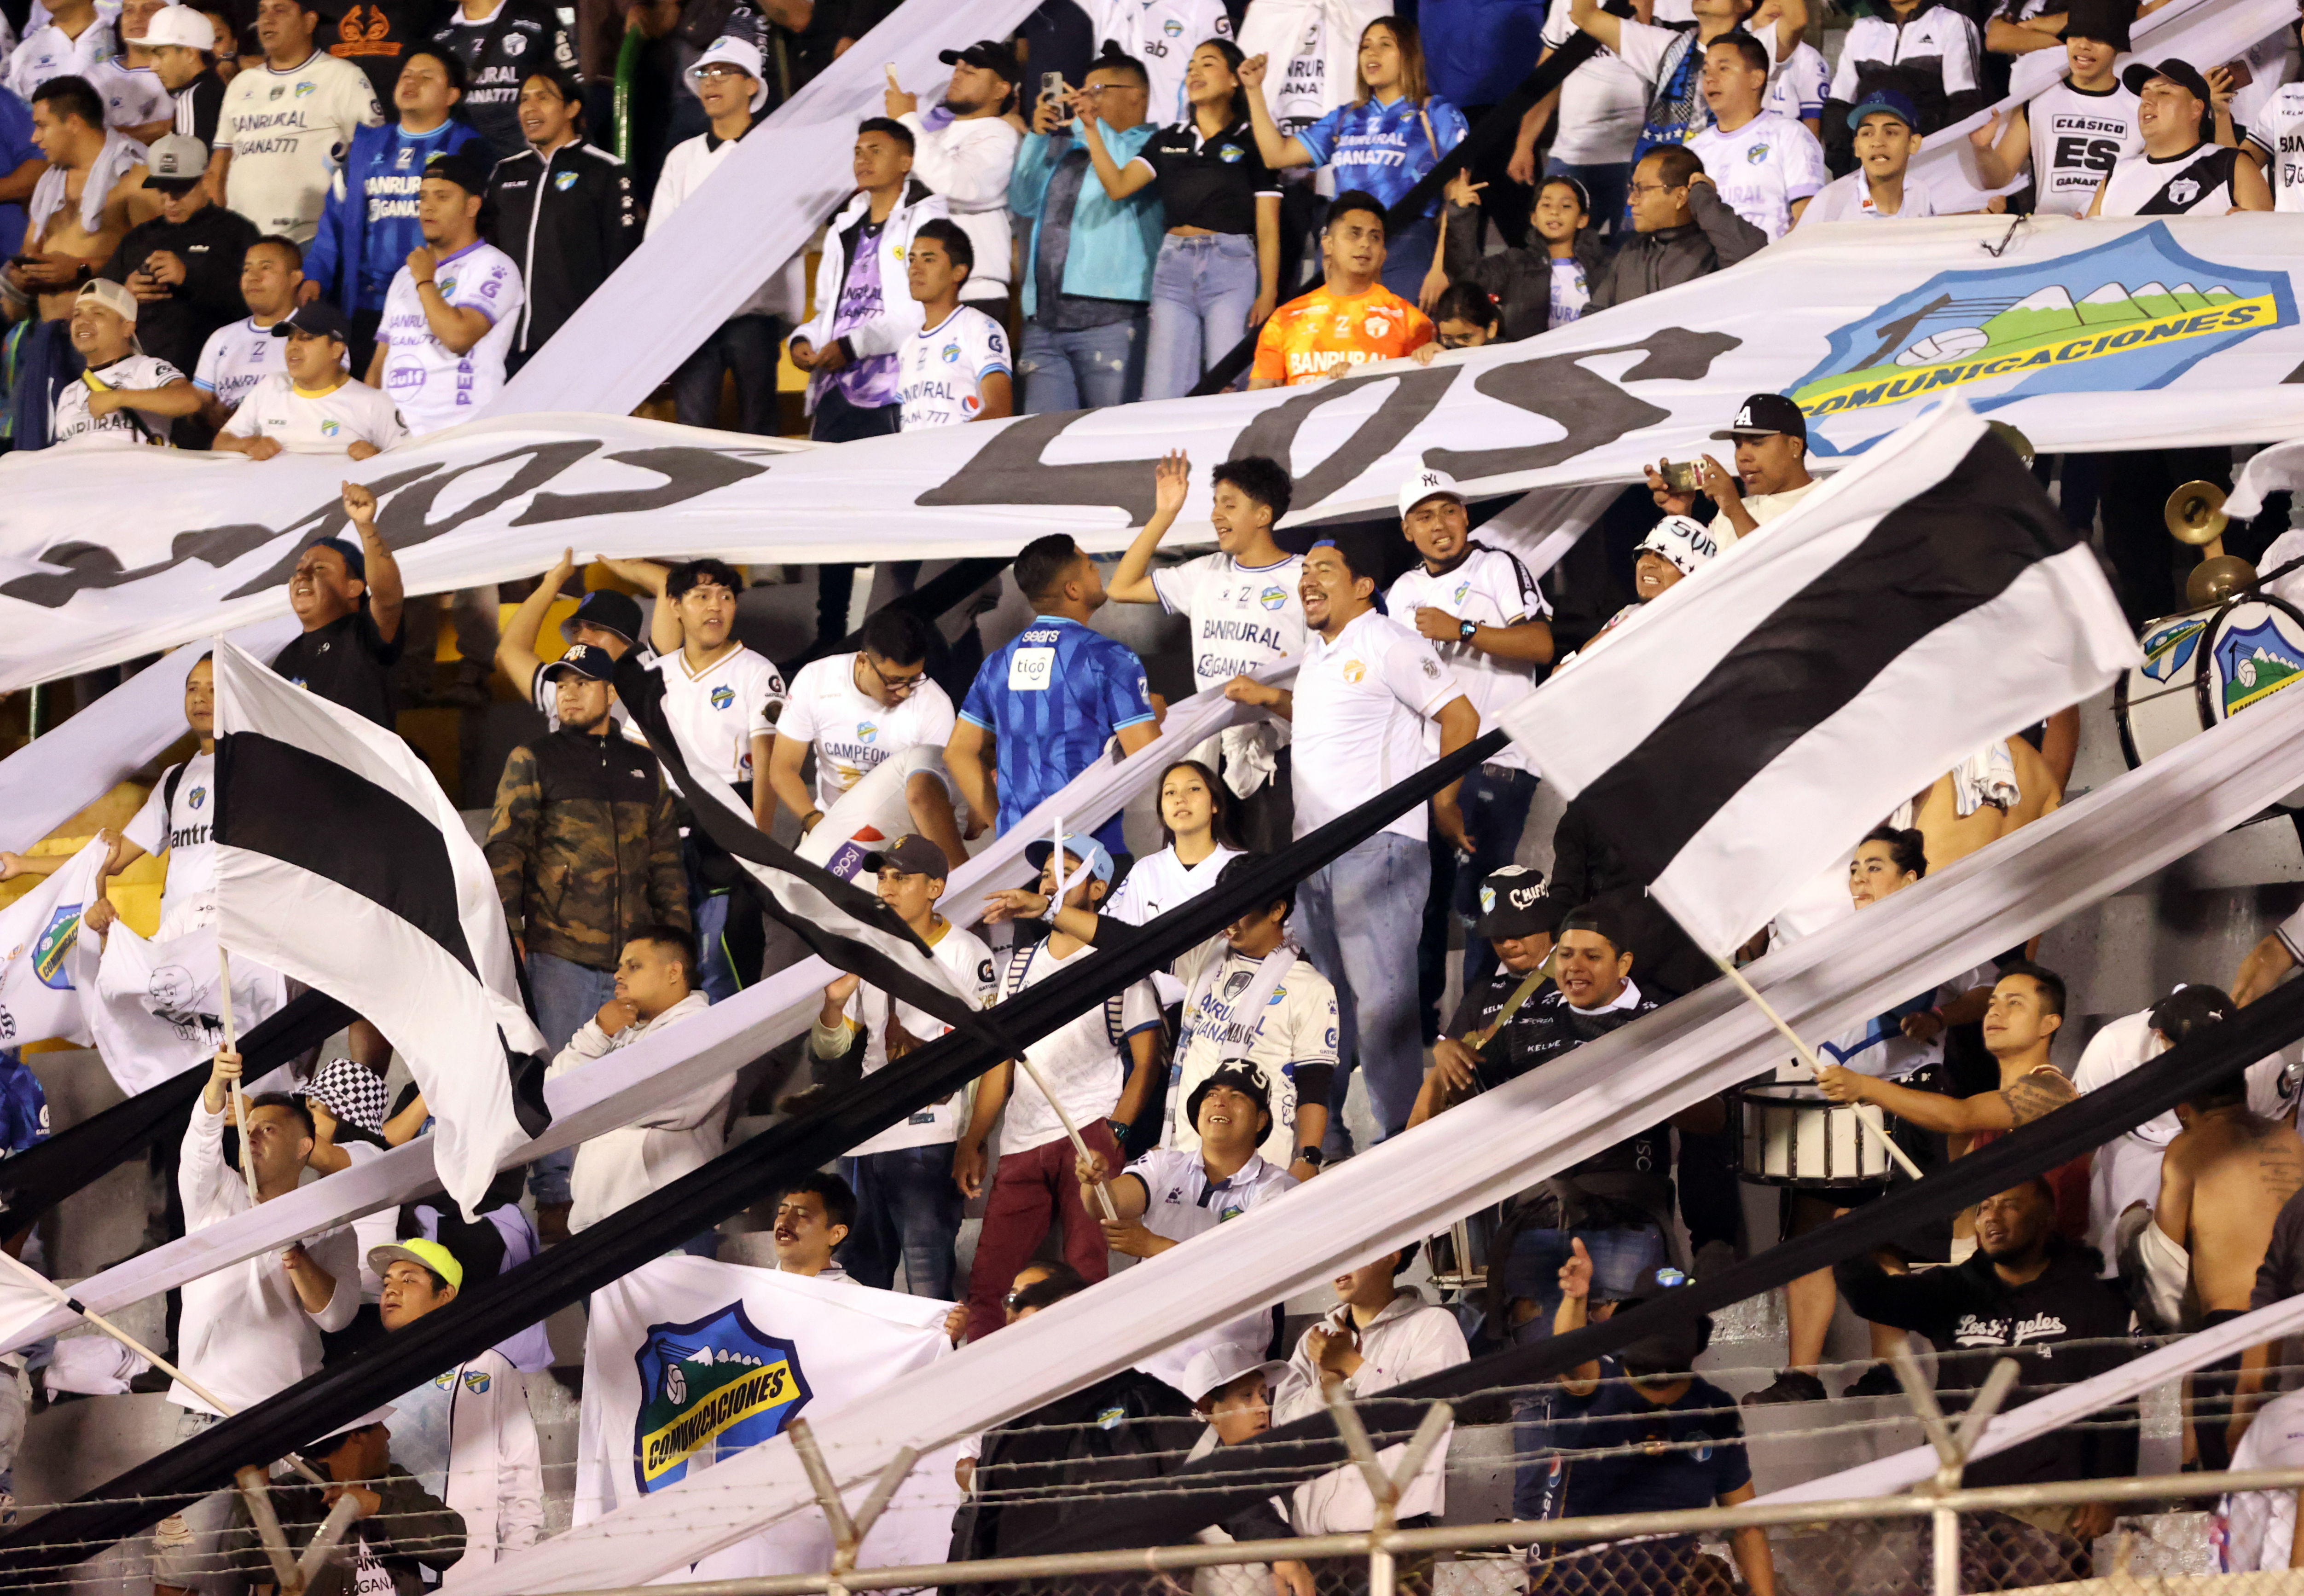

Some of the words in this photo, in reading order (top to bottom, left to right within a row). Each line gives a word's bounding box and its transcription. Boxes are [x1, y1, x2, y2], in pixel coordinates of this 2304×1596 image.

[2055, 116, 2124, 134] CLÁSICO
[400, 148, 414, 162] Z
[2054, 137, 2120, 170] ES
[1336, 316, 1350, 332] Z
[253, 341, 267, 355] Z
[389, 370, 424, 386] Gulf
[1422, 474, 1439, 487] NY
[1239, 585, 1253, 602] Z
[1022, 630, 1060, 643] sears
[1203, 619, 1282, 652] BANRURAL
[1018, 658, 1046, 676] tigo
[172, 822, 213, 849] antr
[978, 958, 995, 983] G
[1527, 1040, 1561, 1052] KELME
[1955, 1313, 1988, 1336] Los
[2037, 1342, 2052, 1358] LA
[648, 1367, 786, 1471] COMUNICACIONES
